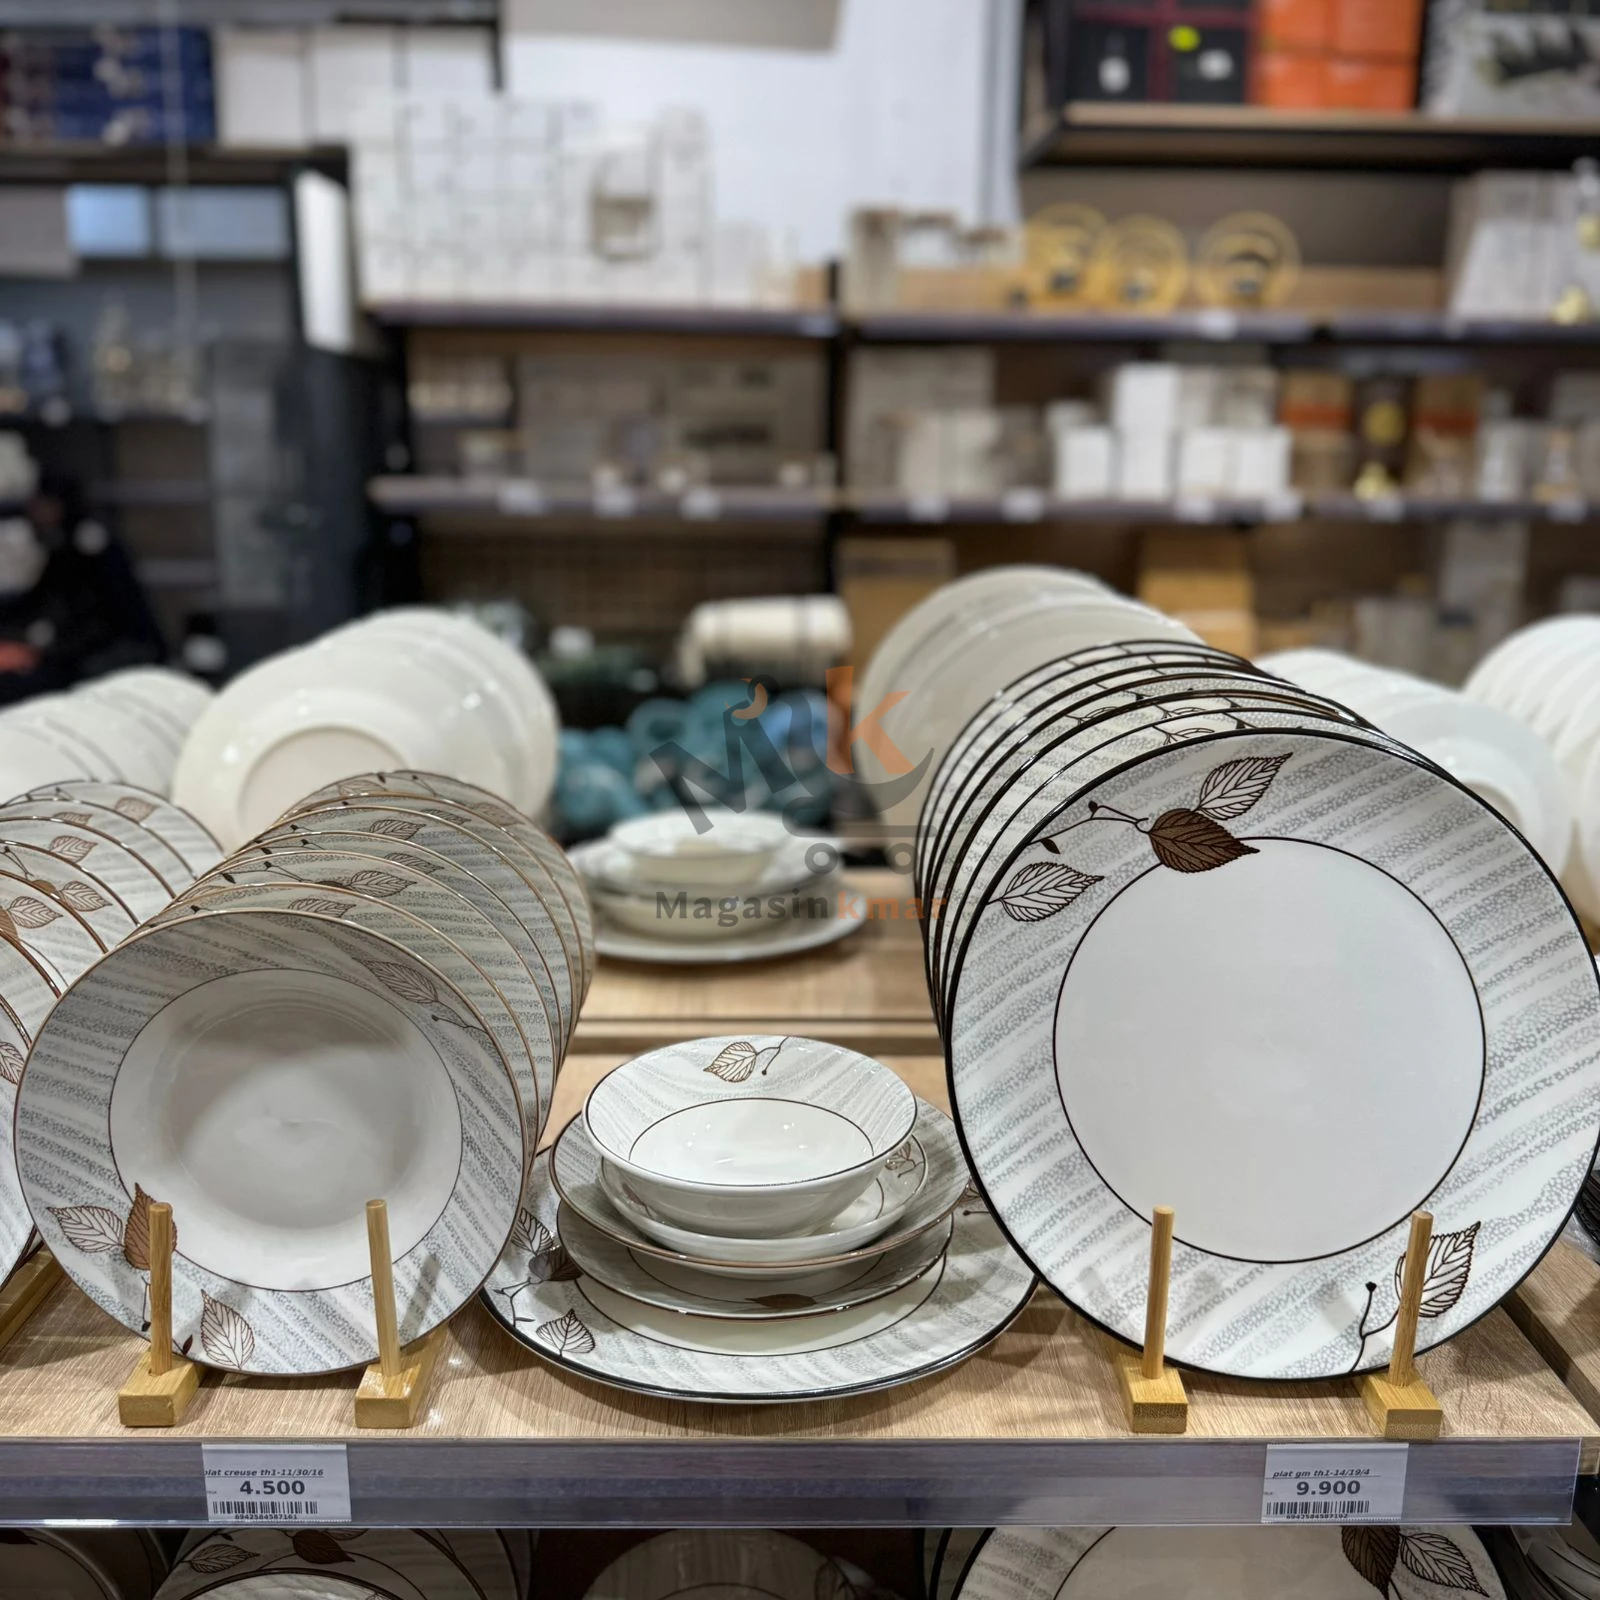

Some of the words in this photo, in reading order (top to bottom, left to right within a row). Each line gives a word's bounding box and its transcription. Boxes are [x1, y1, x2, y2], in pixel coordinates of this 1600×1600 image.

[1272, 1470, 1292, 1479] plat
[1313, 1468, 1370, 1477] th1-14/19/4
[239, 1480, 305, 1495] 4.500
[1296, 1480, 1361, 1495] 9.900
